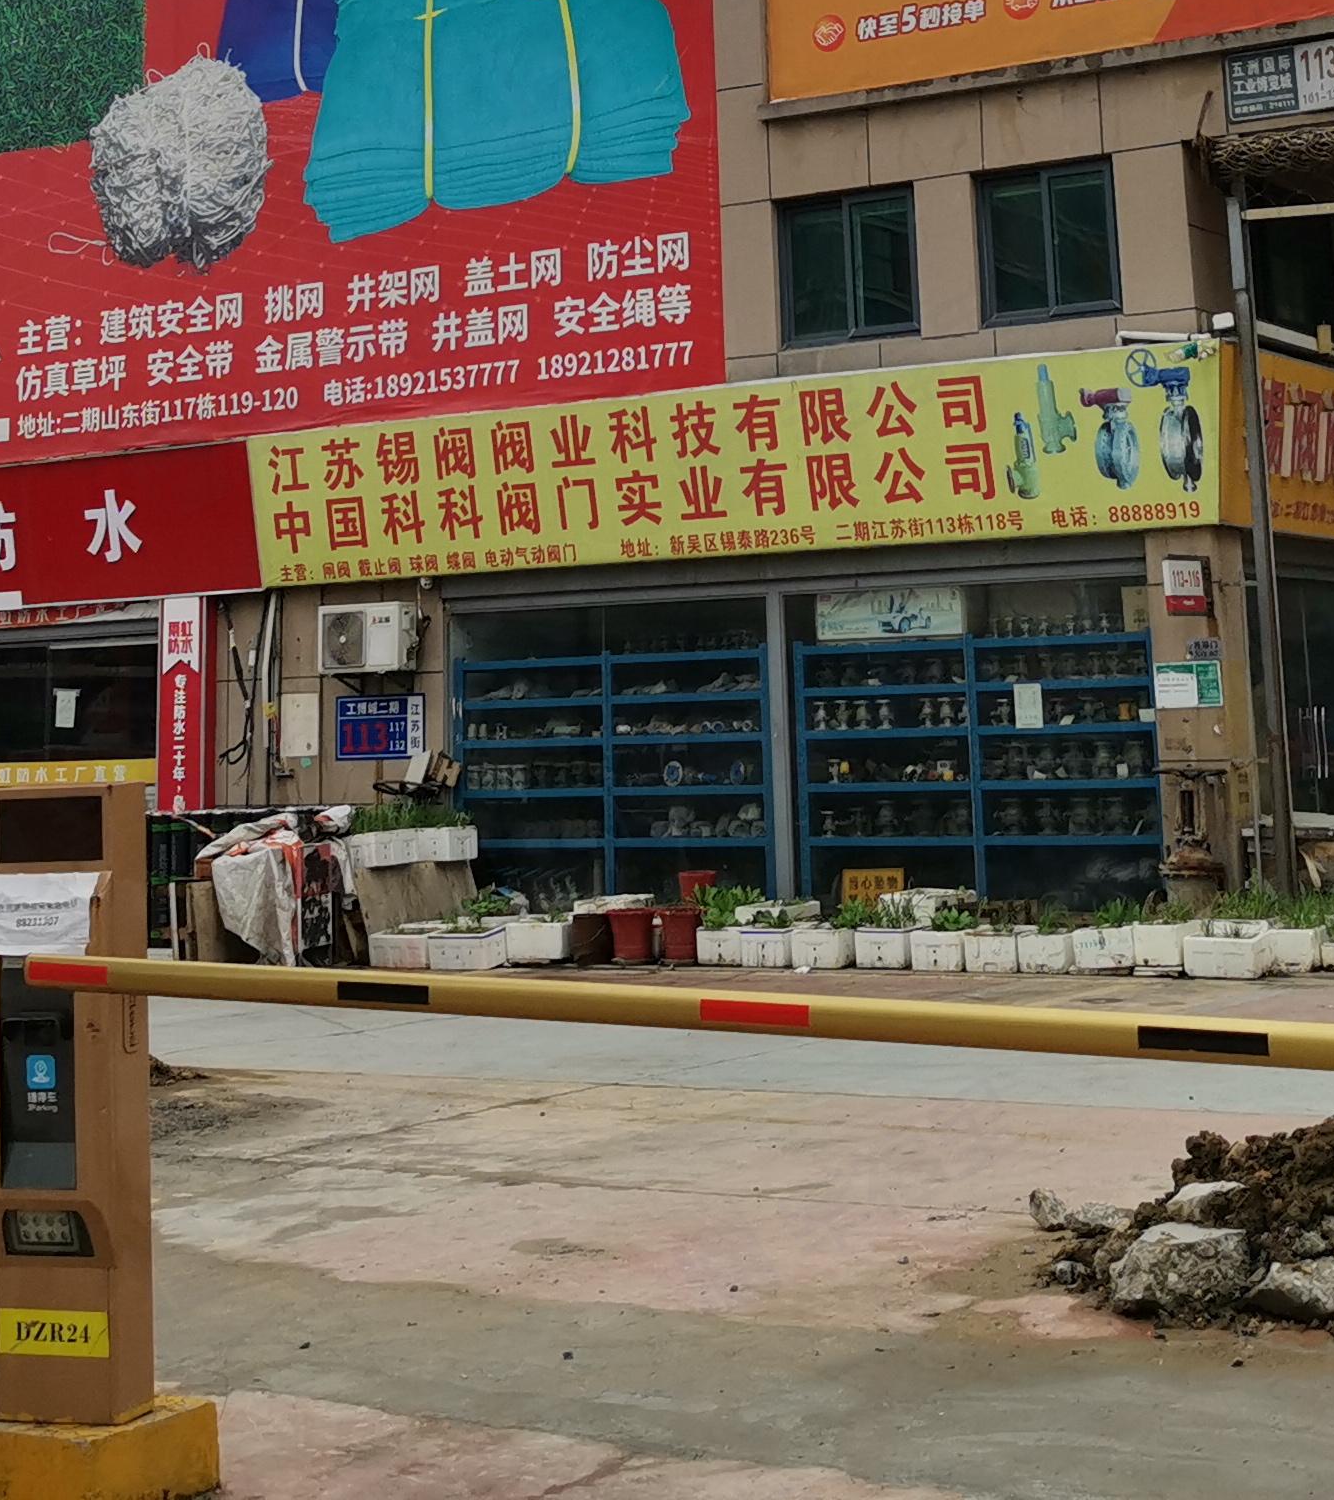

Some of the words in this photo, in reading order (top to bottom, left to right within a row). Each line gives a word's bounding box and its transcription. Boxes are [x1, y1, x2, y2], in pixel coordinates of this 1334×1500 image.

[857, 0, 986, 41] 快至5秒接单
[347, 265, 440, 315] 井架网
[464, 248, 562, 298] 盖土网
[587, 232, 690, 282] 防尘网
[16, 355, 127, 403] 仿真草坪
[147, 341, 234, 388] 安全带
[255, 319, 408, 375] 金属警示带
[432, 304, 529, 353] 井盖网
[553, 283, 692, 338] 安全绳等
[323, 359, 520, 406] 电话:18921537777
[537, 341, 694, 381] 18921281777
[267, 373, 990, 496] 江苏锡阀阀业科技有限公司
[273, 441, 1000, 555] 中国科科阀门实业有限公司
[409, 553, 439, 573] 球阀
[485, 543, 577, 568] 电动气动阀门
[835, 510, 1024, 543] 二期江苏街113栋118号
[1172, 570, 1200, 588] 113-116
[168, 620, 193, 637] 雨虹
[168, 637, 193, 654] 防水
[343, 723, 388, 753] 113
[389, 721, 405, 732] 117
[389, 740, 405, 751] 132
[411, 704, 420, 748] 江苏街
[16, 1321, 91, 1344] DZR24
